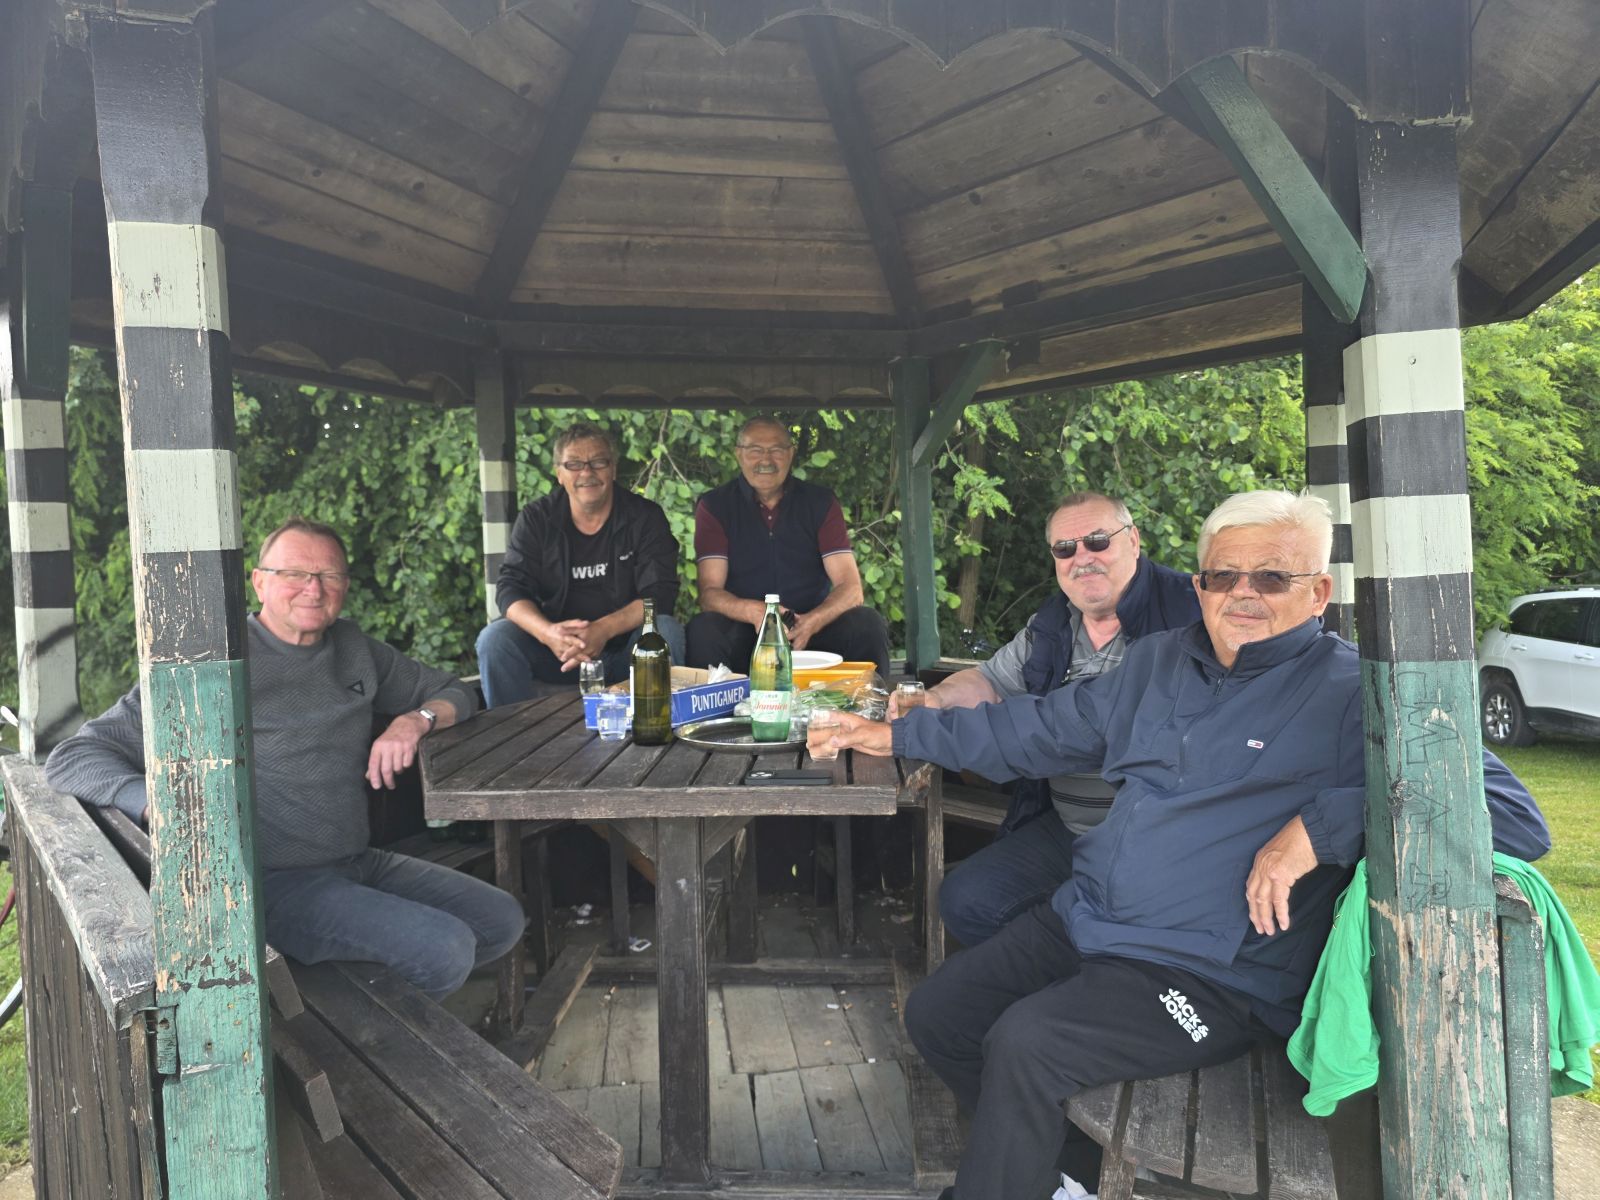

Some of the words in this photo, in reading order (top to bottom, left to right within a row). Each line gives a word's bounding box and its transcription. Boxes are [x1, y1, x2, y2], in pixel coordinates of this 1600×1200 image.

[572, 563, 608, 579] WUR
[691, 686, 744, 714] PUNTIGAMER
[1158, 993, 1202, 1043] JONES
